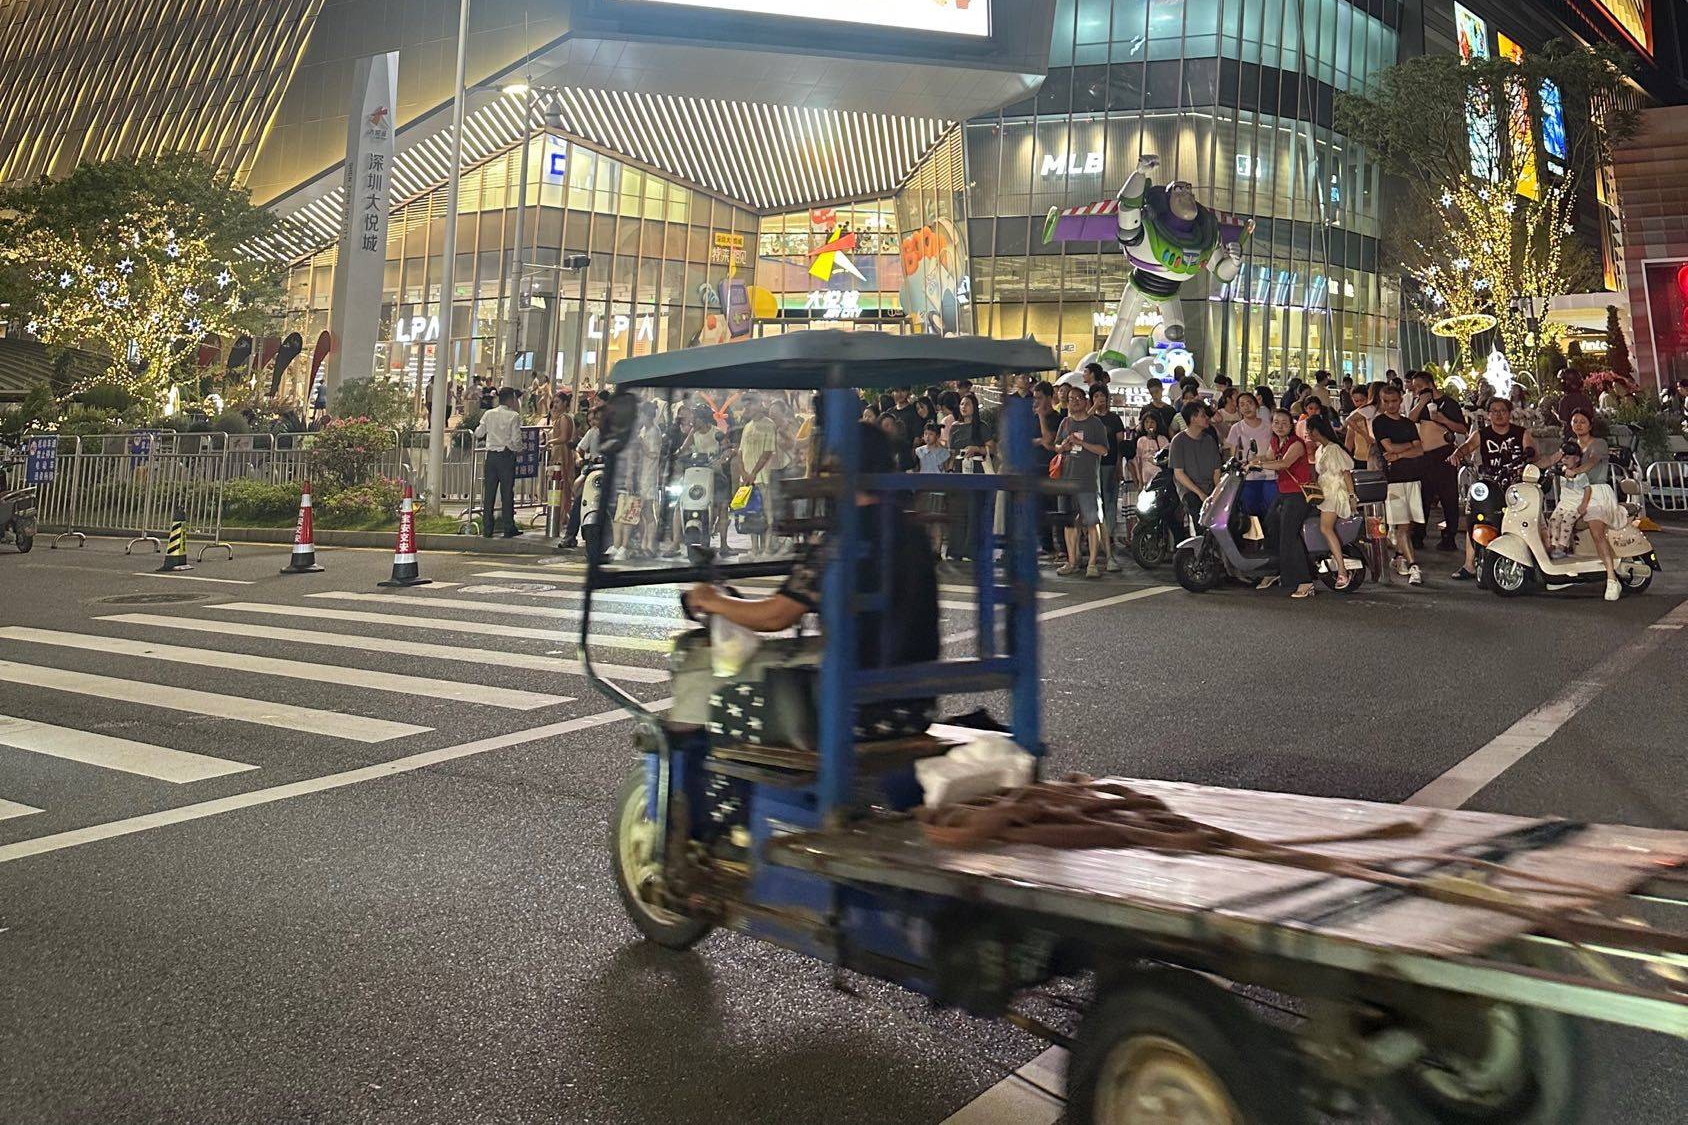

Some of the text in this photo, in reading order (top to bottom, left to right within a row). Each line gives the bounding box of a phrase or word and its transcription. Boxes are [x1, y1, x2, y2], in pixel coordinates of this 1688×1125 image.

[1041, 152, 1104, 175] MLB
[362, 153, 384, 252] 深圳大悦城
